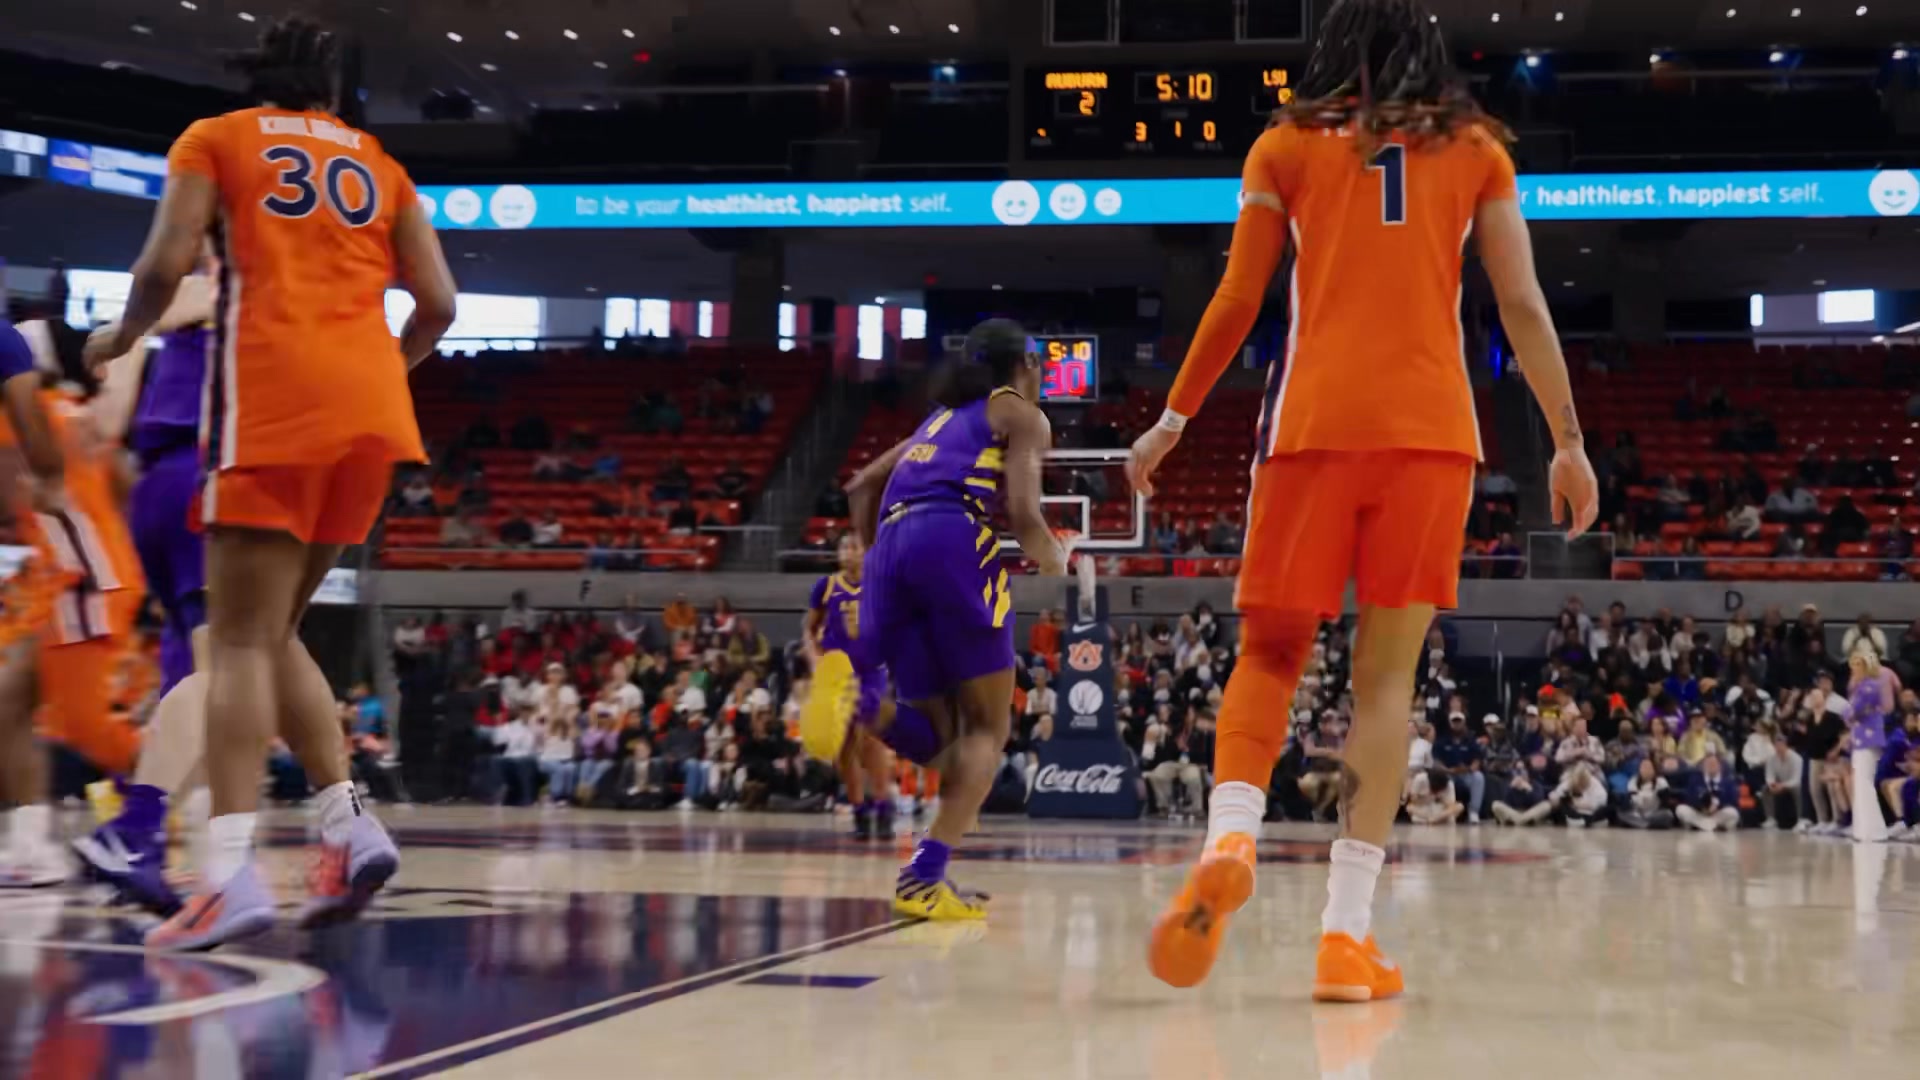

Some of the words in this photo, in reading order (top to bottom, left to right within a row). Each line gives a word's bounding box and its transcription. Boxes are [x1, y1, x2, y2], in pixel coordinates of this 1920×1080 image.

[1156, 74, 1212, 101] 5:10
[1263, 70, 1287, 86] LSU
[1079, 91, 1095, 116] 2
[1135, 121, 1148, 142] 3
[1174, 120, 1182, 138] 1
[1203, 121, 1216, 142] 0
[259, 144, 380, 228] 30
[1366, 143, 1407, 226] 1
[1668, 183, 1771, 208] happiest
[1779, 182, 1825, 204] self.
[575, 195, 599, 216] to
[603, 195, 630, 216] be
[635, 199, 682, 217] your
[807, 193, 903, 217] happiest
[909, 193, 953, 213] self.
[580, 579, 592, 601] F
[1131, 586, 1144, 608] E
[1725, 590, 1744, 612] D
